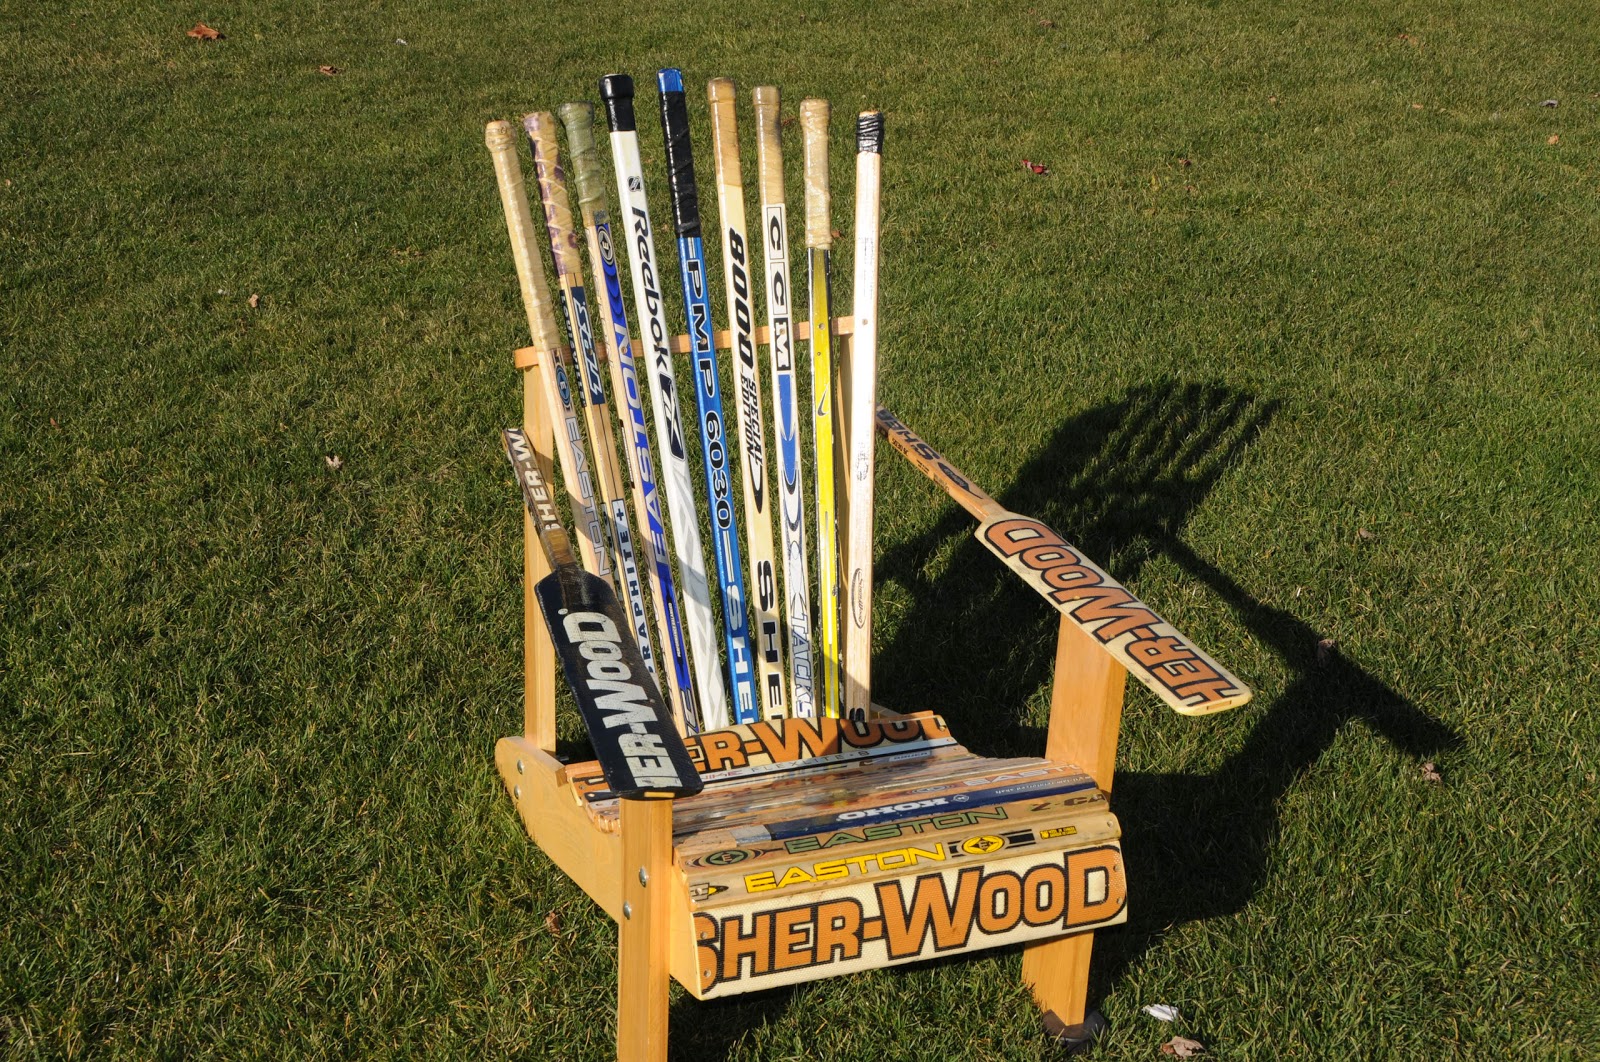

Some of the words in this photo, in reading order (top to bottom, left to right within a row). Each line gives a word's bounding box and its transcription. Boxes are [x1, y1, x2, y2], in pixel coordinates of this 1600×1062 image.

[631, 207, 672, 373] Reebok
[728, 227, 753, 370] 8000
[613, 323, 668, 566] EASTON
[740, 373, 756, 457] EDITION
[746, 377, 763, 466] SPECIAL
[507, 428, 561, 530] HER-W
[565, 416, 610, 576] EASTON
[686, 260, 715, 398] PMP
[704, 410, 730, 529] 6030
[725, 584, 758, 724] SHE
[757, 560, 783, 721] SHE
[792, 611, 812, 719] TACKS
[744, 842, 946, 894] EASTON
[784, 806, 1008, 854] EASTON
[838, 797, 949, 821] KOHO
[693, 845, 1127, 995] SHER-WOOD
